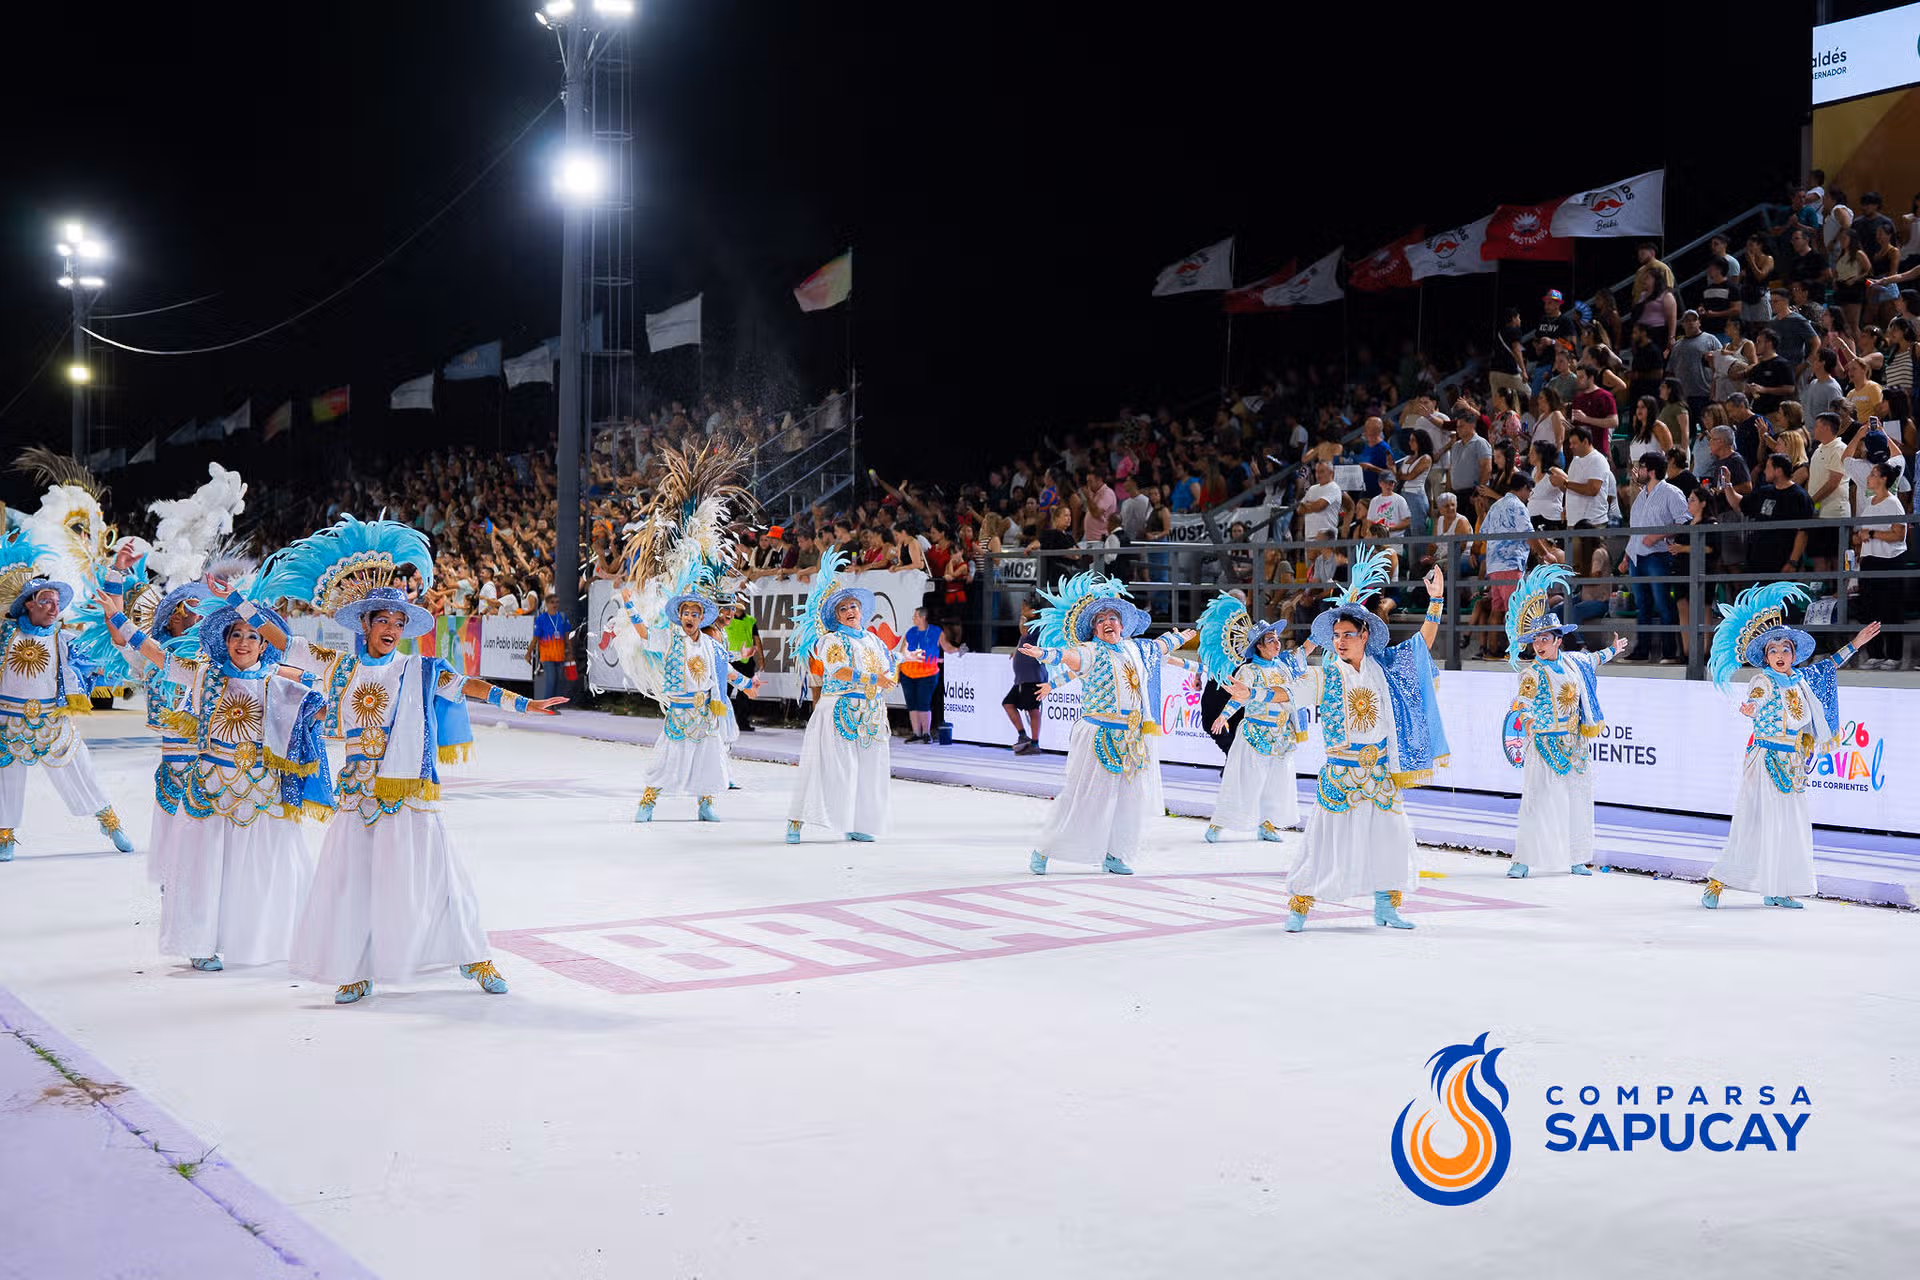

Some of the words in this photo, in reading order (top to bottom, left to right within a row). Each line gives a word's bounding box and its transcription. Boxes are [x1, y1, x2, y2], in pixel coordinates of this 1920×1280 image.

[1047, 692, 1082, 704] GOBIERN
[1615, 726, 1633, 740] DE
[1589, 743, 1657, 766] IENTES
[1812, 780, 1822, 788] DE
[1823, 781, 1869, 792] CORRIENTES
